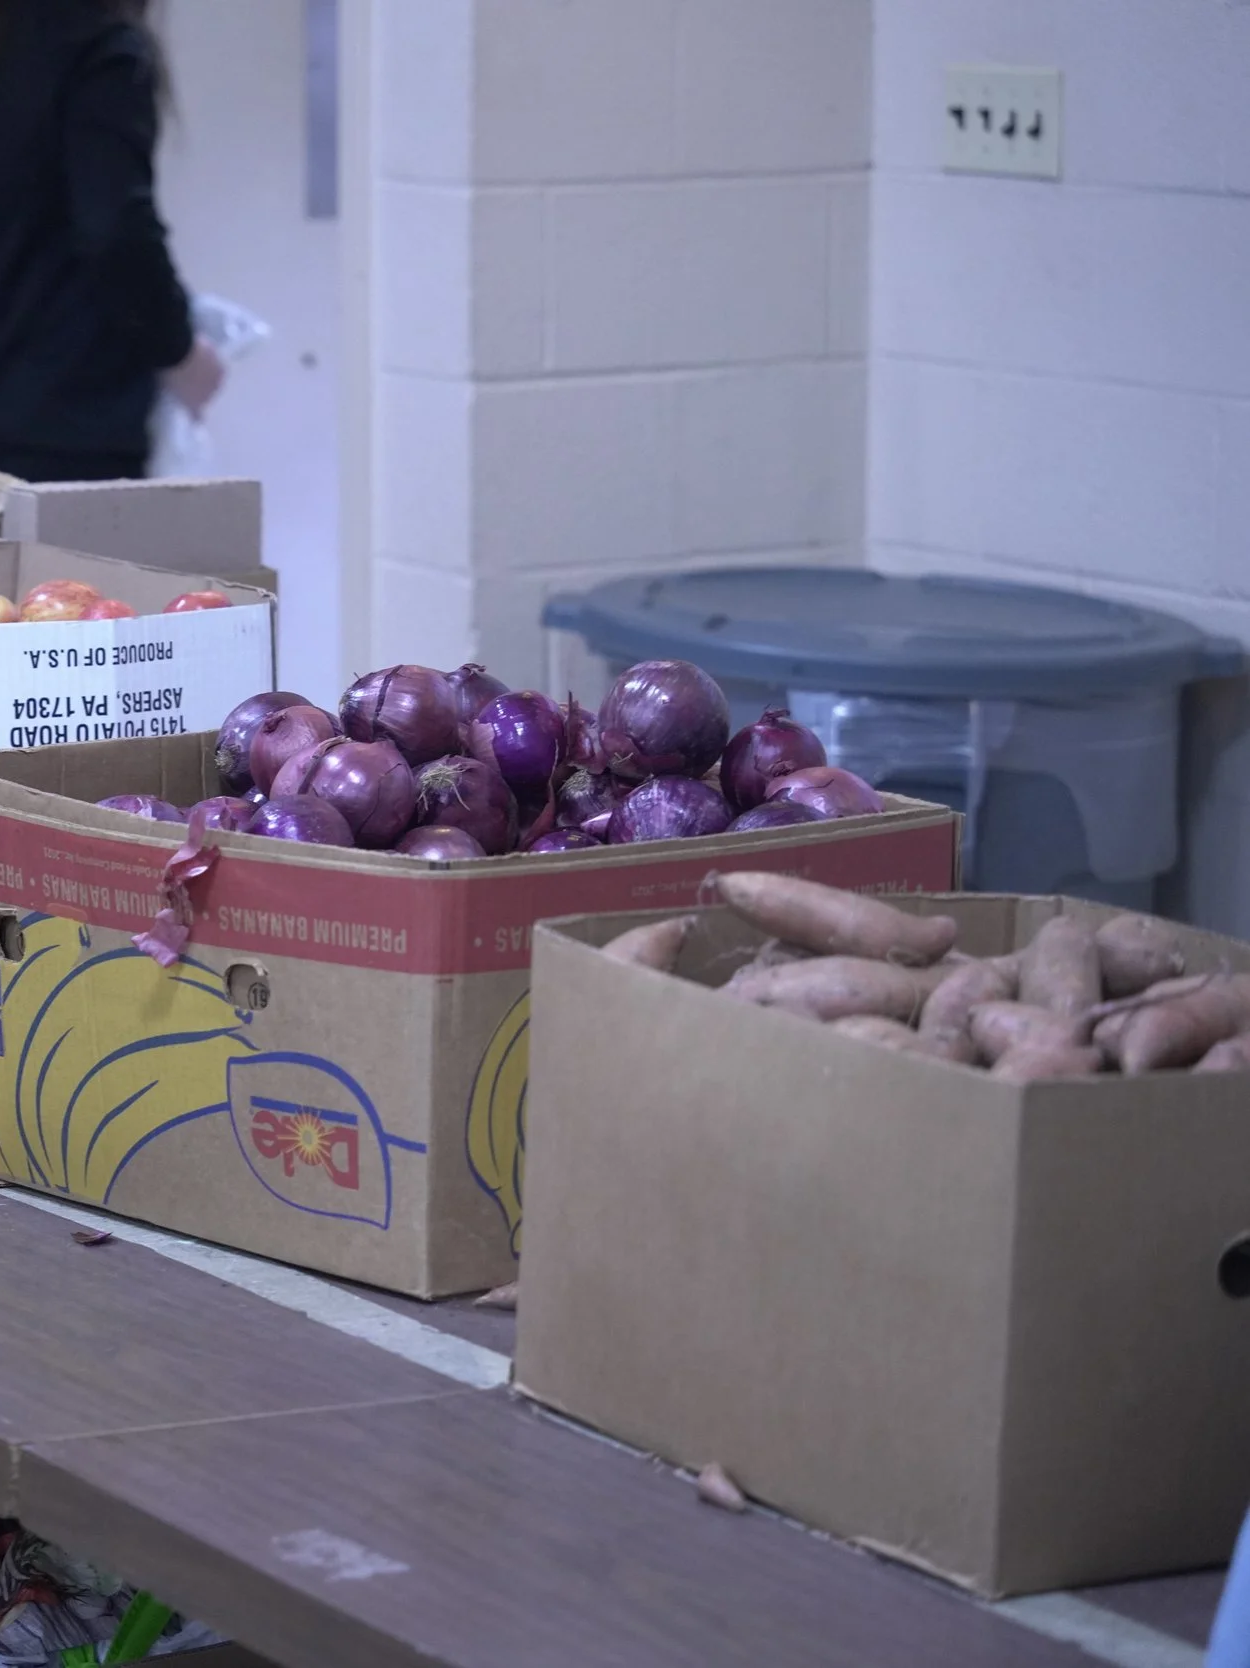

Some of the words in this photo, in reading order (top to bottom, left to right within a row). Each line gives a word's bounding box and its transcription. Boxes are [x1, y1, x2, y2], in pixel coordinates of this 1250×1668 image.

[23, 648, 78, 669] U.S.A.
[84, 647, 106, 667] OF
[113, 641, 172, 665] PRODUCE
[13, 696, 75, 719] 17304
[82, 695, 108, 716] PA
[117, 687, 183, 715] ASPERS,
[10, 725, 67, 748] ROAD
[151, 715, 187, 736] 1415
[42, 873, 110, 910] BANANAS
[219, 905, 308, 941] BANANAS
[313, 918, 408, 954] PREMIUM
[252, 1110, 360, 1191] Dole
